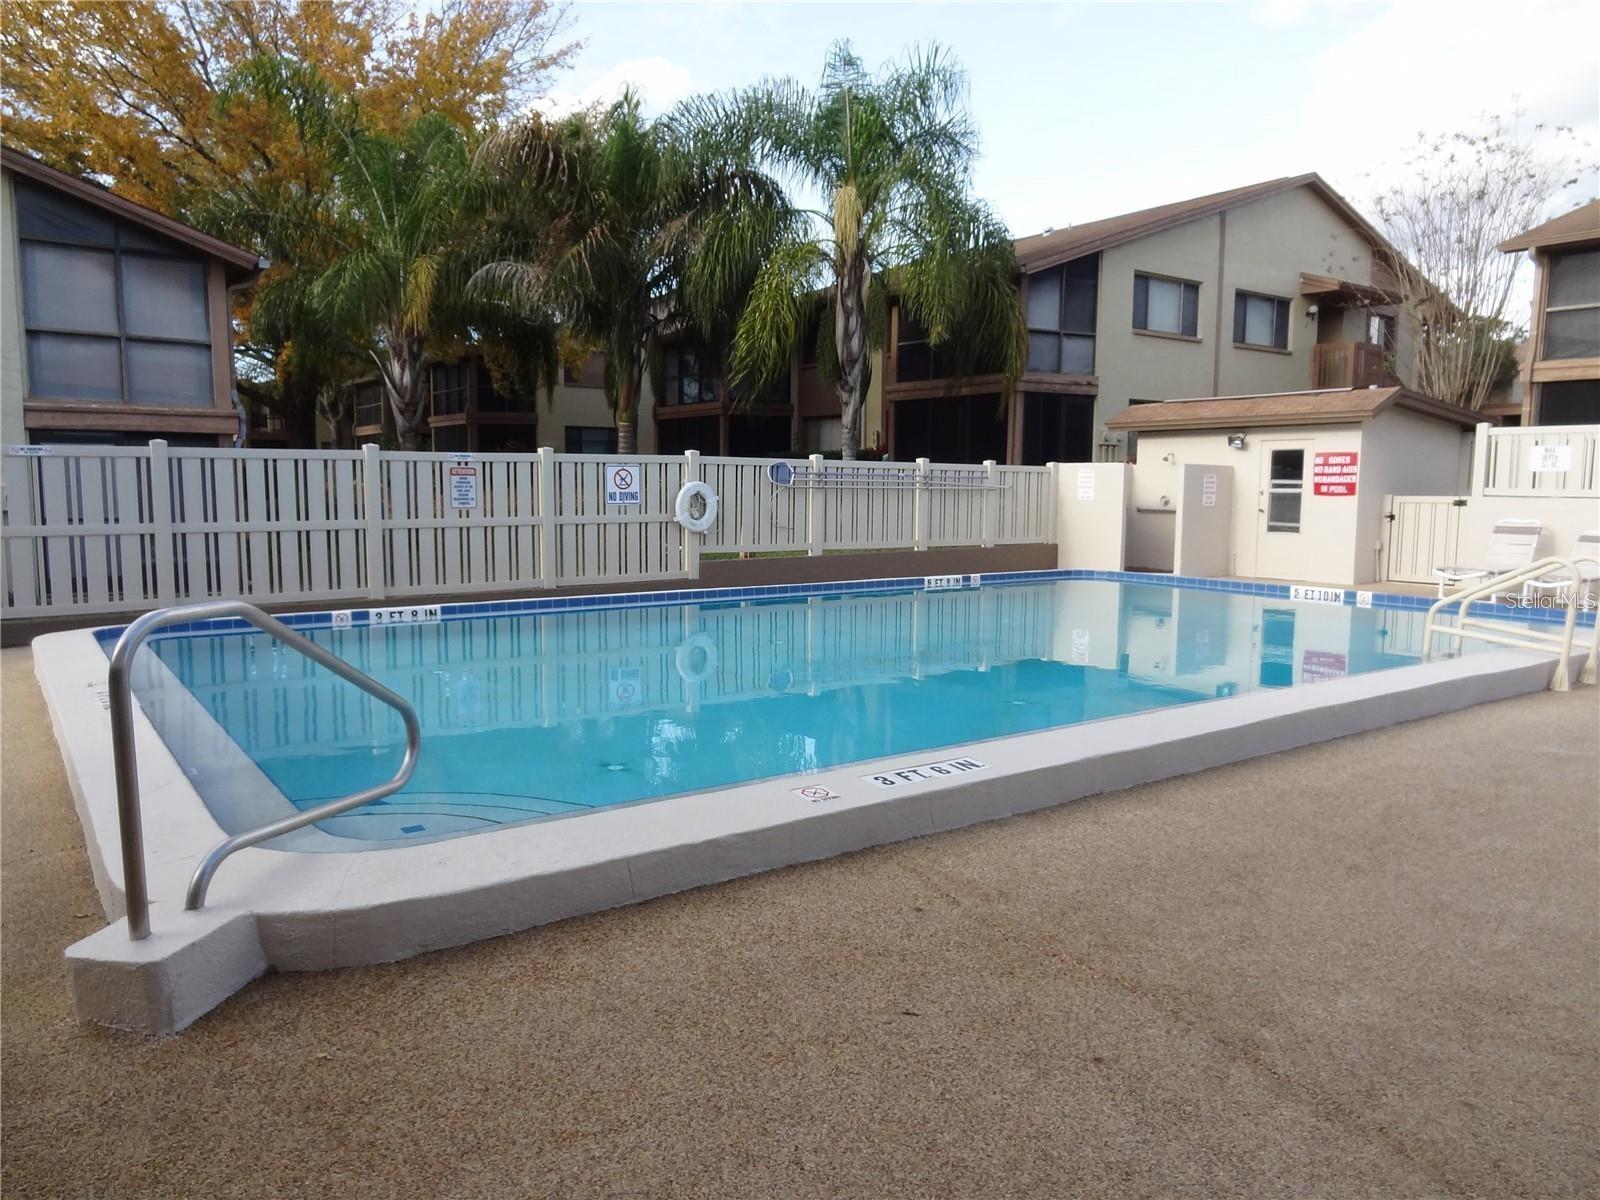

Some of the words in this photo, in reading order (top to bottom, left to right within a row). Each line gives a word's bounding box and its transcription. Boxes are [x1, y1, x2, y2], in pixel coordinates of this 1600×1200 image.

[1315, 456, 1324, 464] NO
[1329, 485, 1348, 493] POOL
[608, 491, 617, 501] NO
[618, 491, 639, 501] DIVING
[873, 776, 896, 786] 3
[894, 769, 932, 781] FT.
[929, 766, 952, 775] 6
